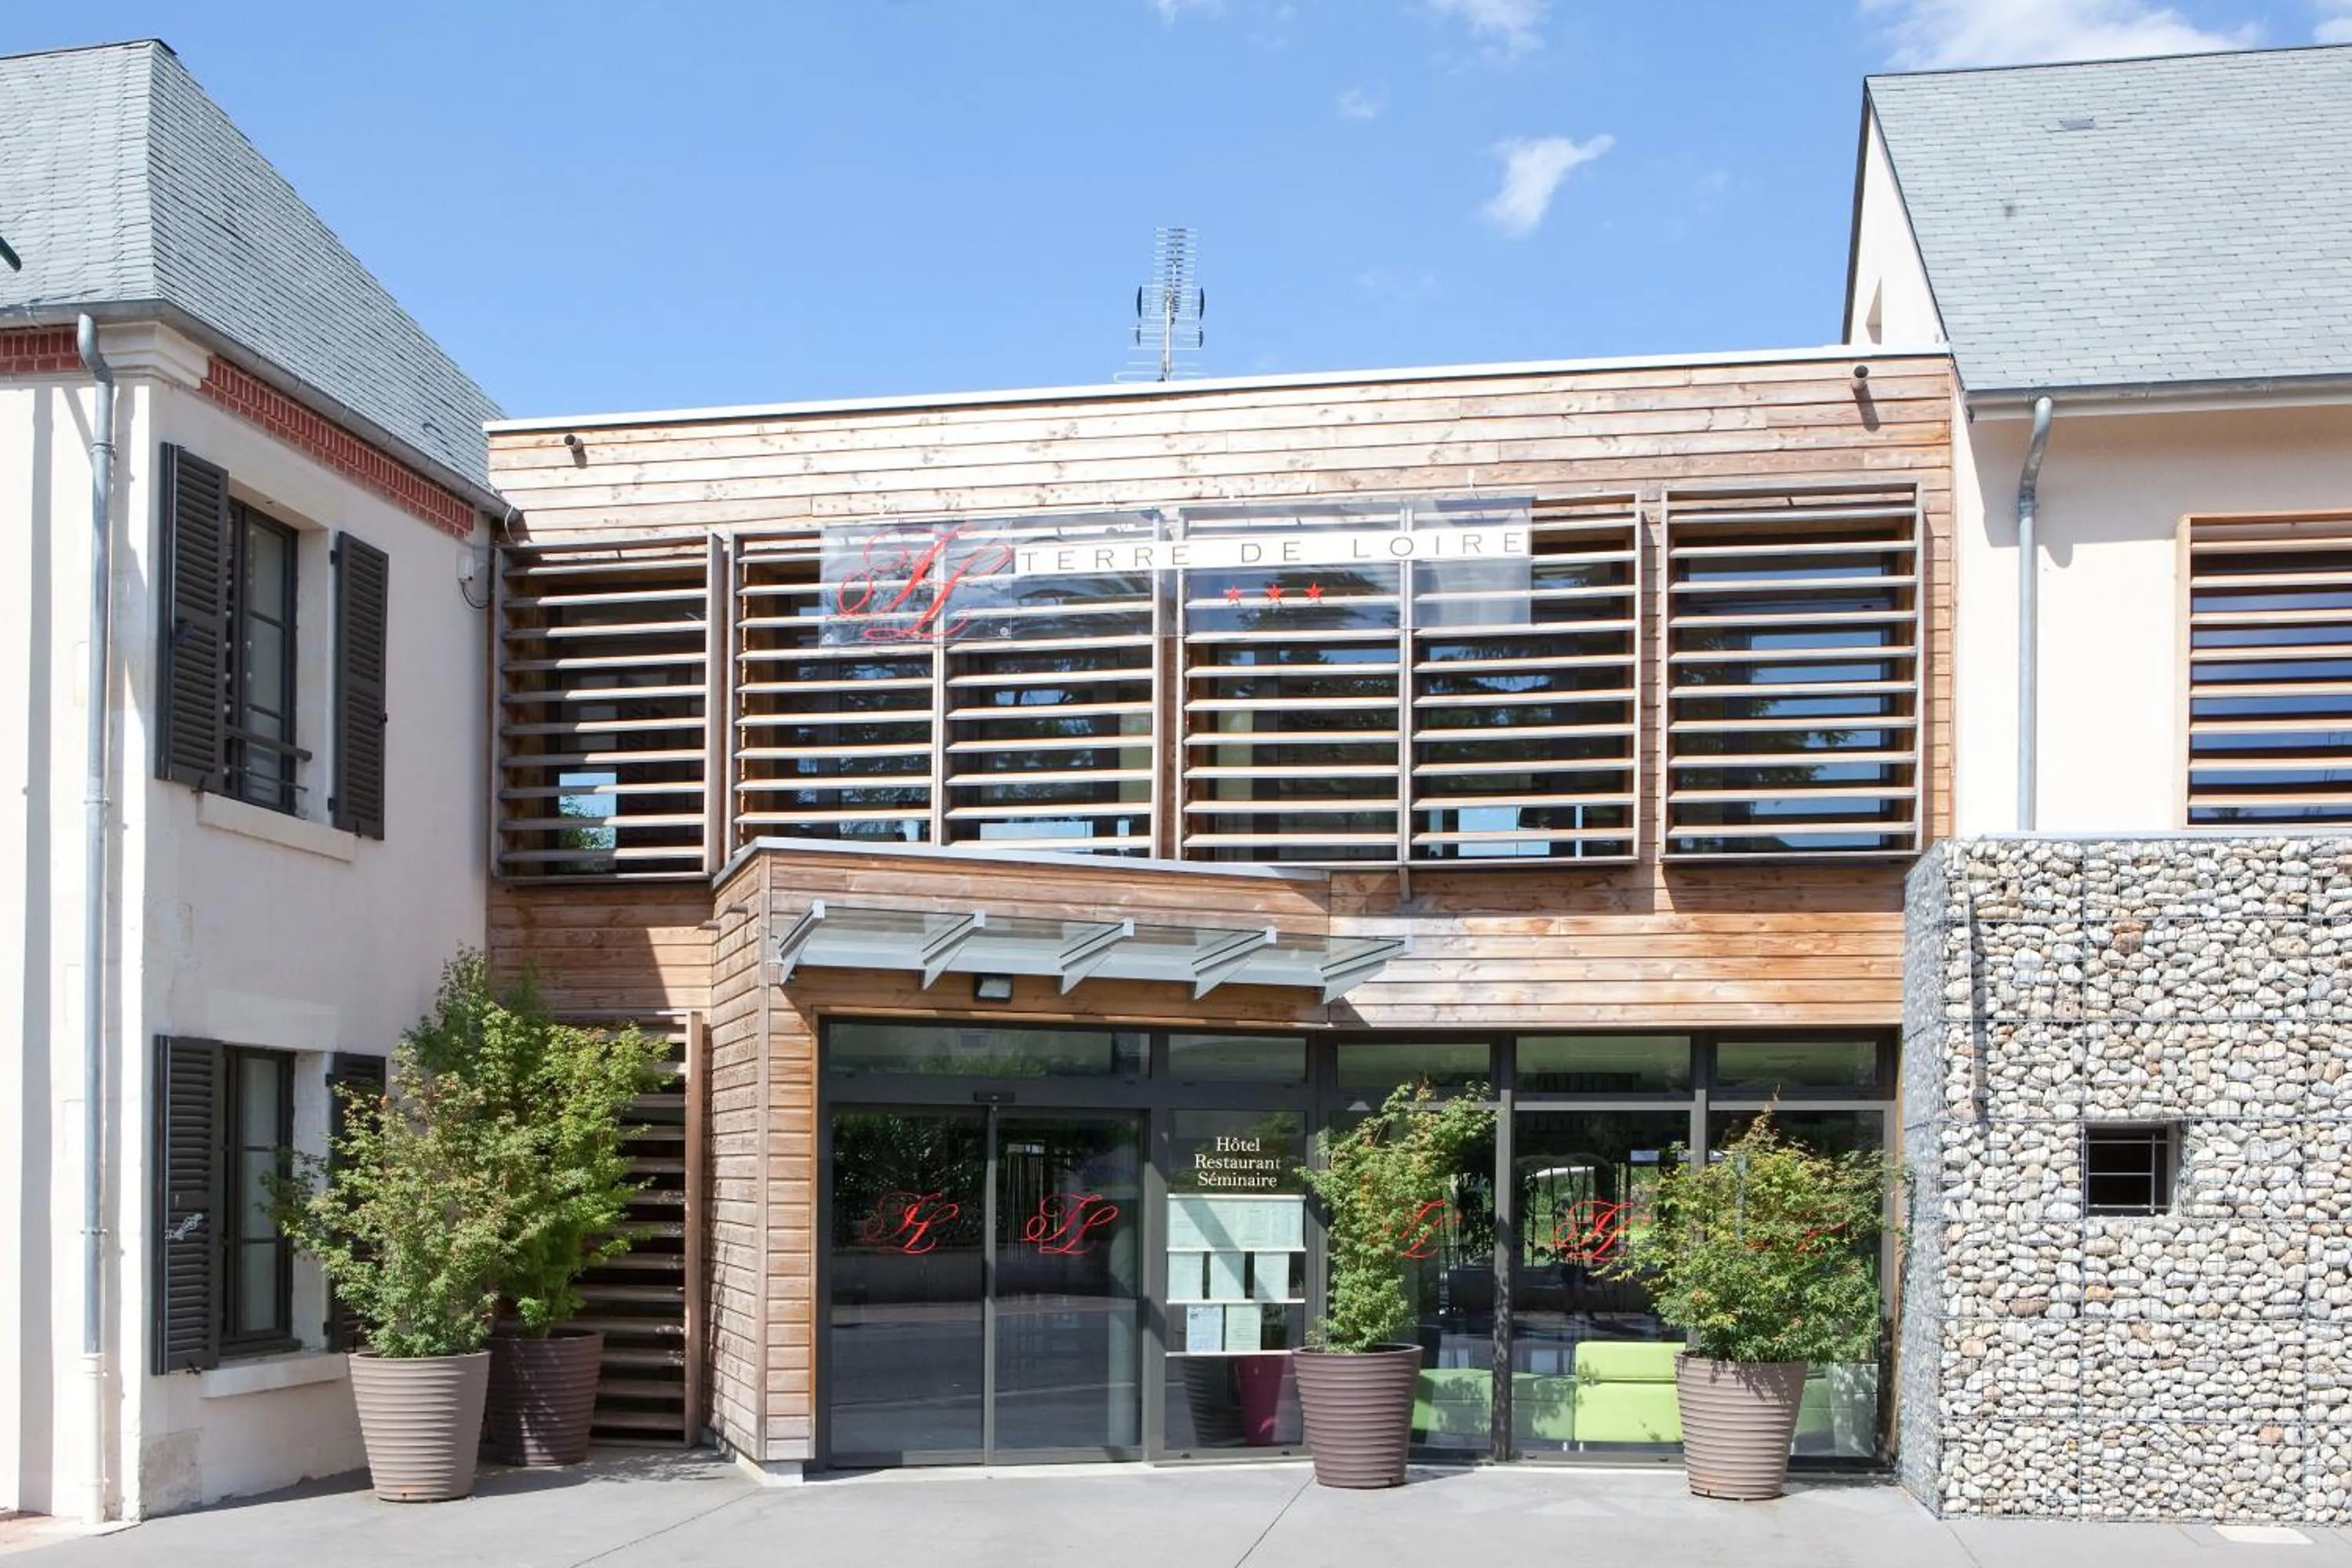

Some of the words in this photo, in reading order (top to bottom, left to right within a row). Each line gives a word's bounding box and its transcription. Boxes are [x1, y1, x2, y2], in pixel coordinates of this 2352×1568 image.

[1020, 545, 1191, 572] TERRE
[1240, 540, 1302, 564] DE
[1352, 532, 1523, 559] LOIRE
[1216, 1135, 1261, 1152] Hôtel
[1194, 1153, 1281, 1169] Restaurant
[1197, 1171, 1278, 1187] Séminaire
